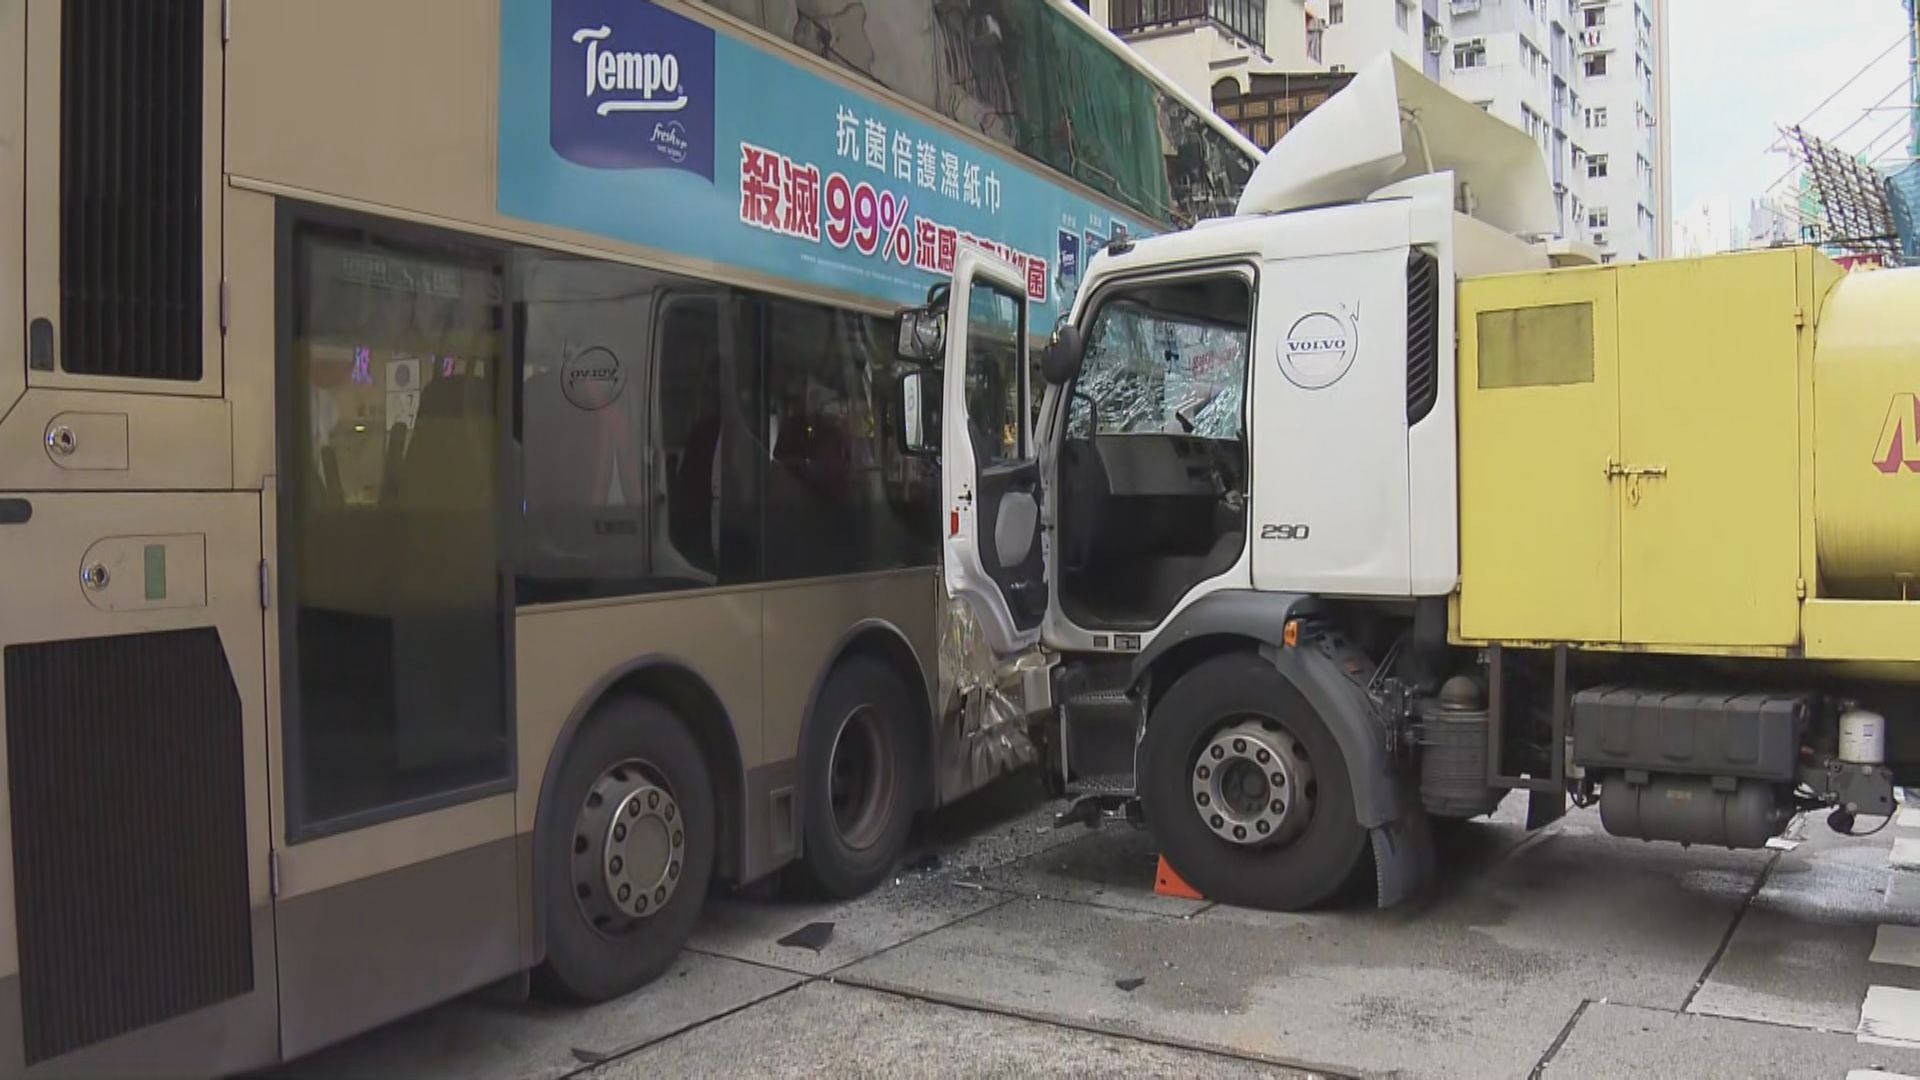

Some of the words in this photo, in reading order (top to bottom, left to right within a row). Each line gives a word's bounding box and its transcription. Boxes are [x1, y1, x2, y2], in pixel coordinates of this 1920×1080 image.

[572, 25, 682, 100] Tempo
[836, 104, 1001, 215] 抗菌倍護濕紙巾
[1287, 340, 1346, 351] VOLVO
[1260, 524, 1309, 540] 290
